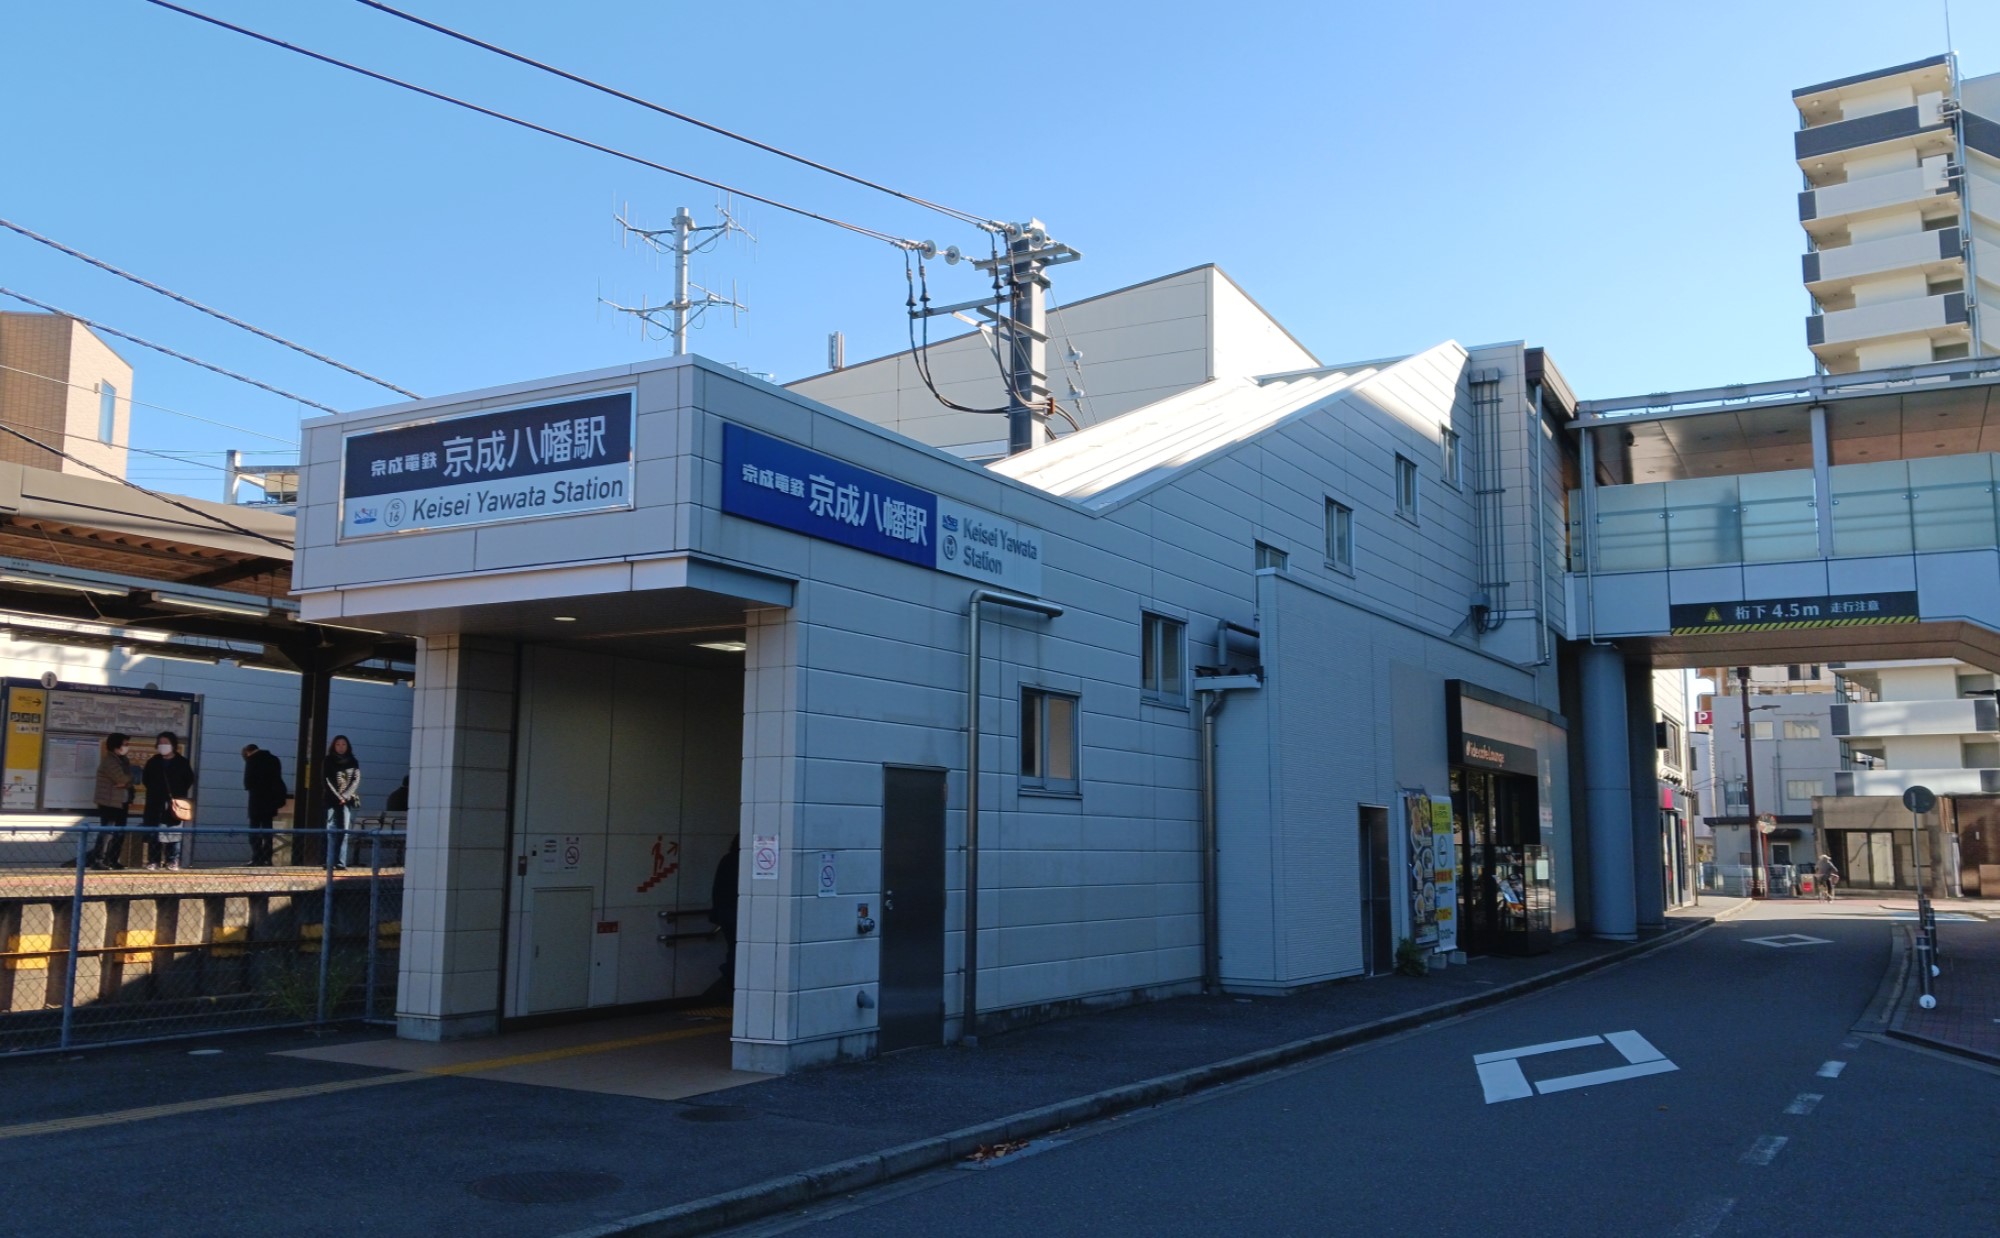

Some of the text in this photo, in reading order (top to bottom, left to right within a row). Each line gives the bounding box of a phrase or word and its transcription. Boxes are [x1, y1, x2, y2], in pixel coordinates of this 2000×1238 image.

[370, 415, 606, 478] 京成電鉄 京成八幡駅
[412, 475, 624, 521] Keisei Yawata Station
[742, 463, 928, 547] 京成電鉄 京成八幡駅
[389, 511, 400, 523] 16
[963, 517, 1038, 560] Keisei Yawata
[963, 544, 1003, 576] Station
[1735, 600, 1880, 620] 桁下 4.5m 走行注意
[1698, 712, 1709, 724] P
